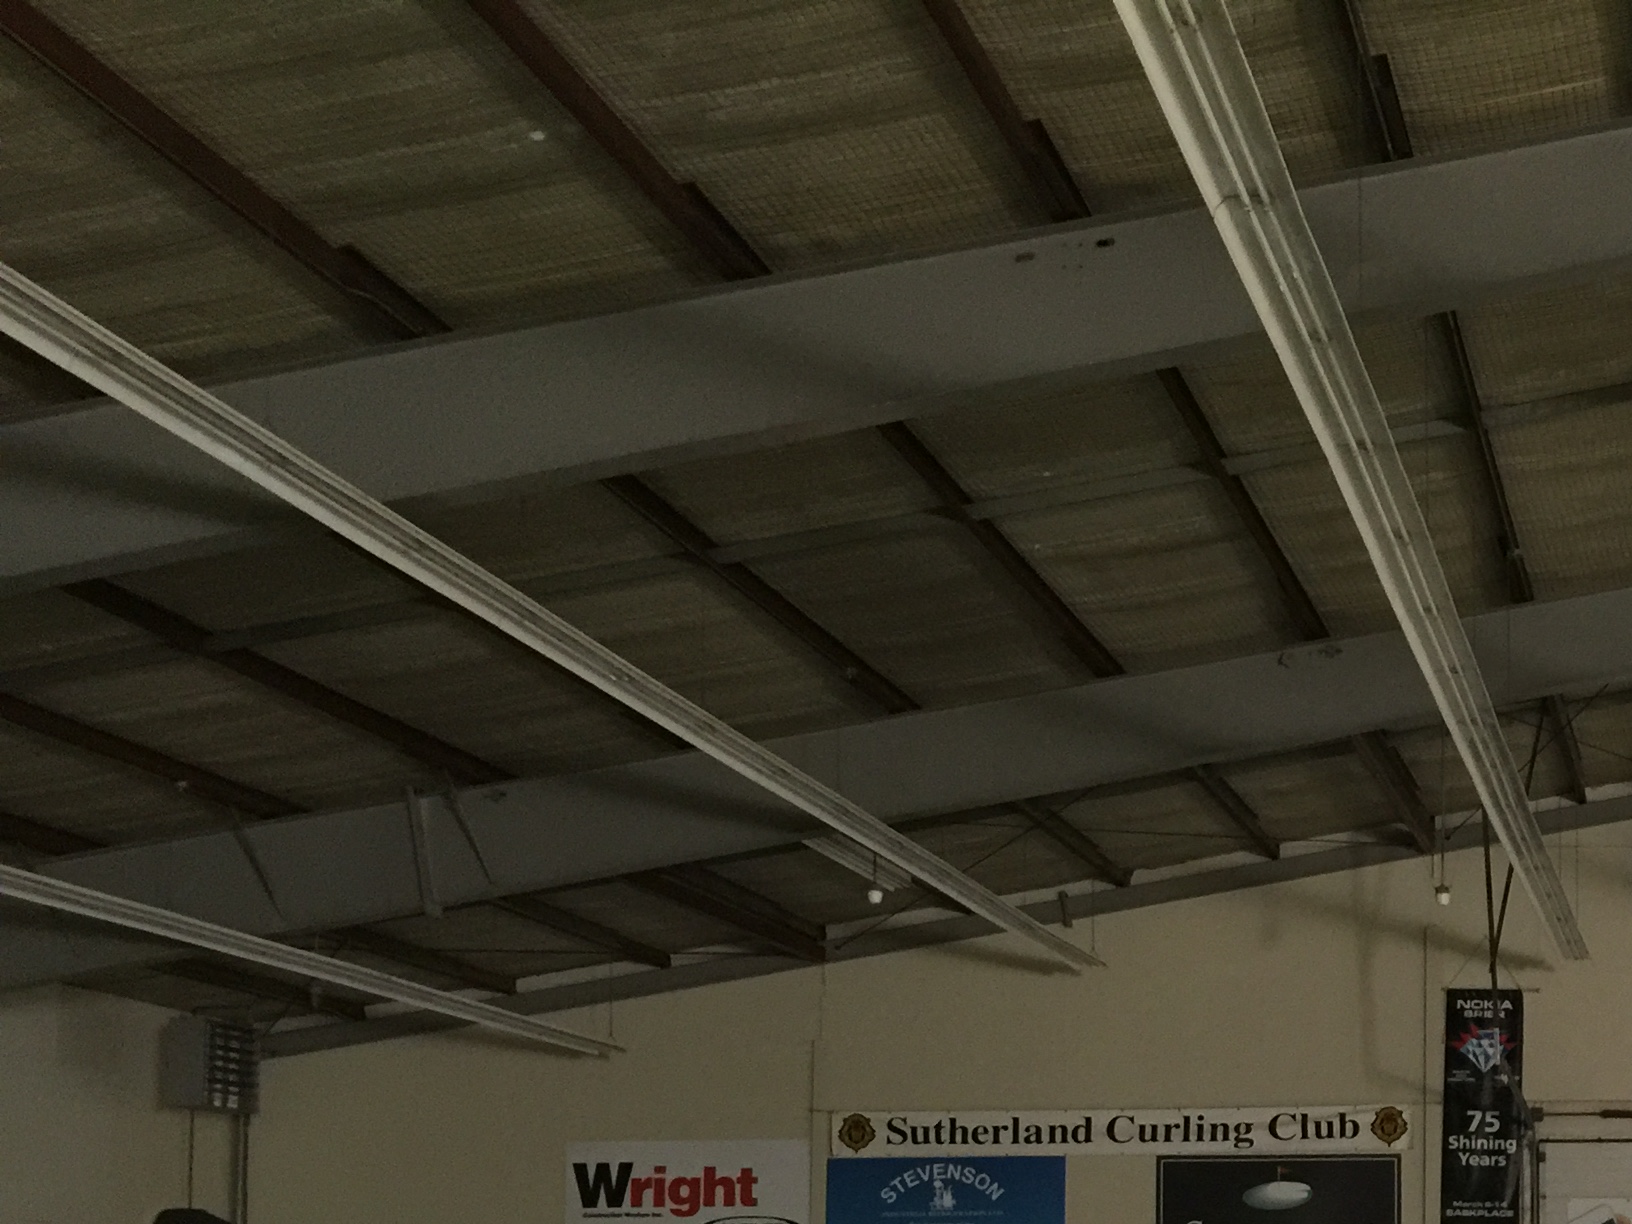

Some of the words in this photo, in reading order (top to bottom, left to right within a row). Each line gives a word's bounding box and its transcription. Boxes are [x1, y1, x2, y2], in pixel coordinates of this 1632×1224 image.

[1457, 1000, 1513, 1009] NOKIA
[886, 1116, 1093, 1145] Sutherland
[1106, 1113, 1254, 1148] Curling
[1268, 1112, 1360, 1141] Club
[1467, 1110, 1500, 1133] 75
[1448, 1135, 1517, 1154] Shining
[1459, 1152, 1507, 1167] Years
[573, 1162, 758, 1217] Wright
[880, 1163, 1005, 1203] STEVENSON
